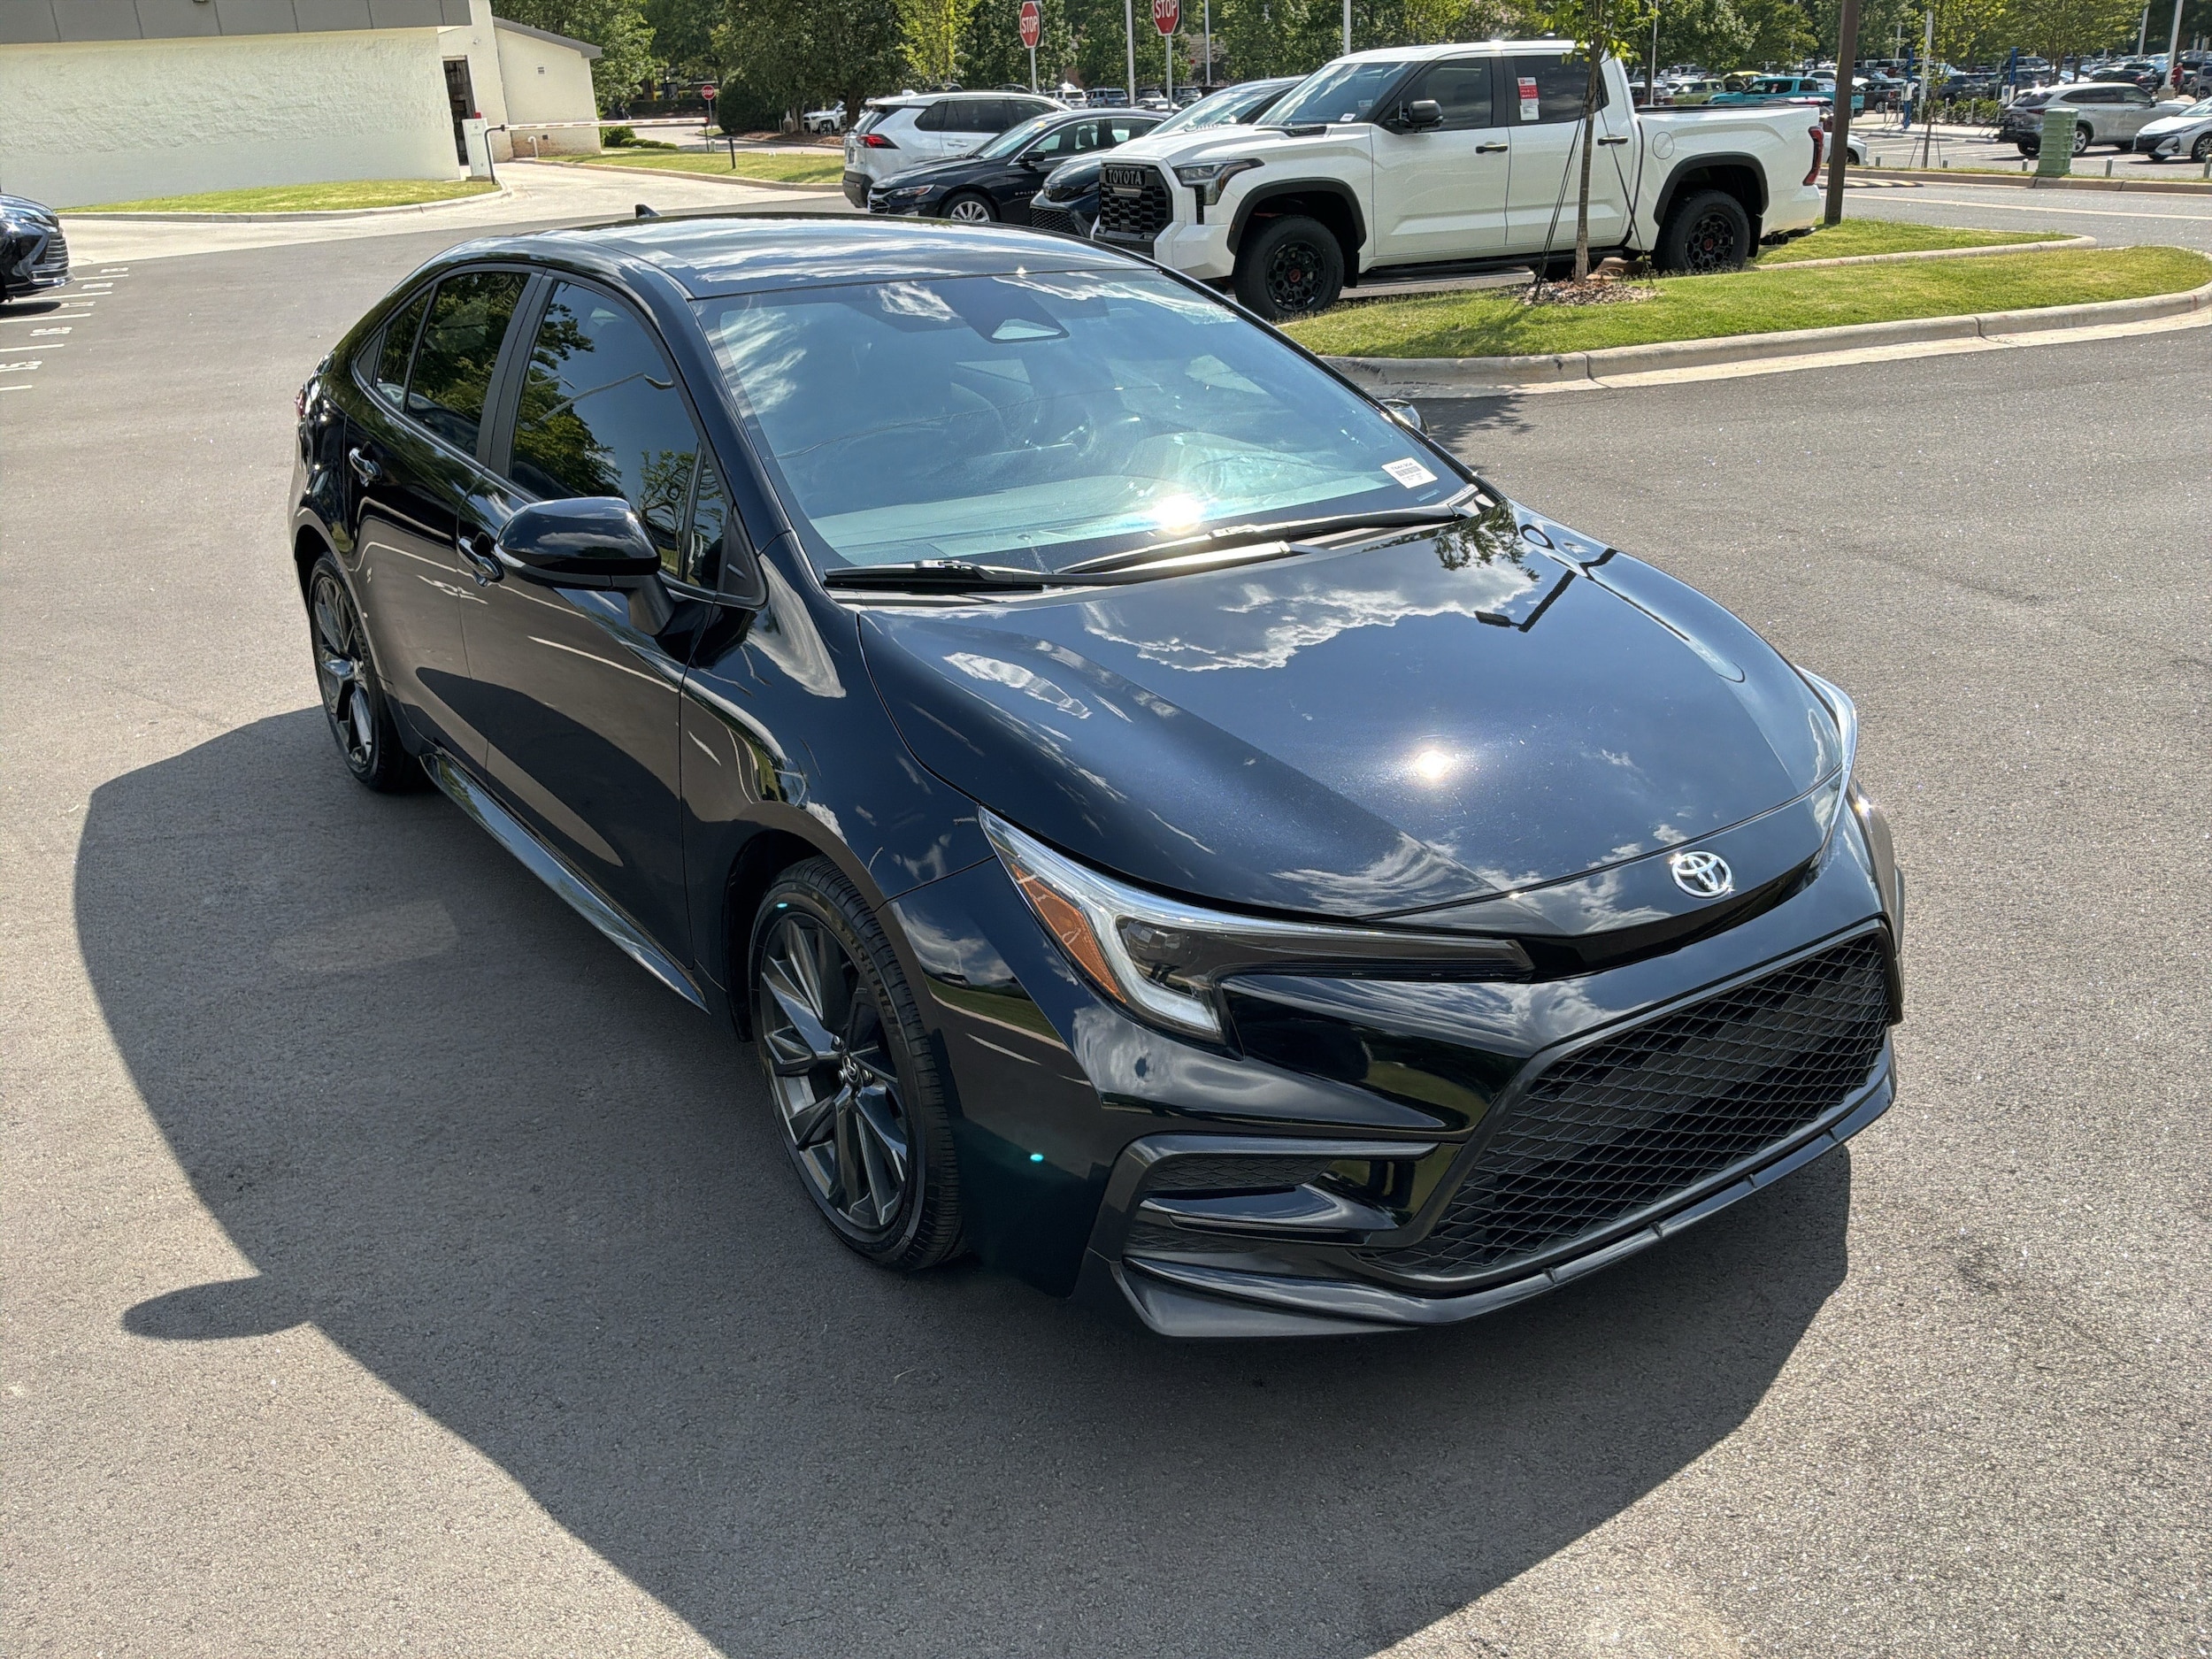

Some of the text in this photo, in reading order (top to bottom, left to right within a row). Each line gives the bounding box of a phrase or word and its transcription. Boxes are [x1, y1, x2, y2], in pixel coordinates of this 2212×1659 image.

[1155, 0, 1177, 19] STOP
[1021, 16, 1038, 34] STOP
[1108, 169, 1142, 185] TOYOTA
